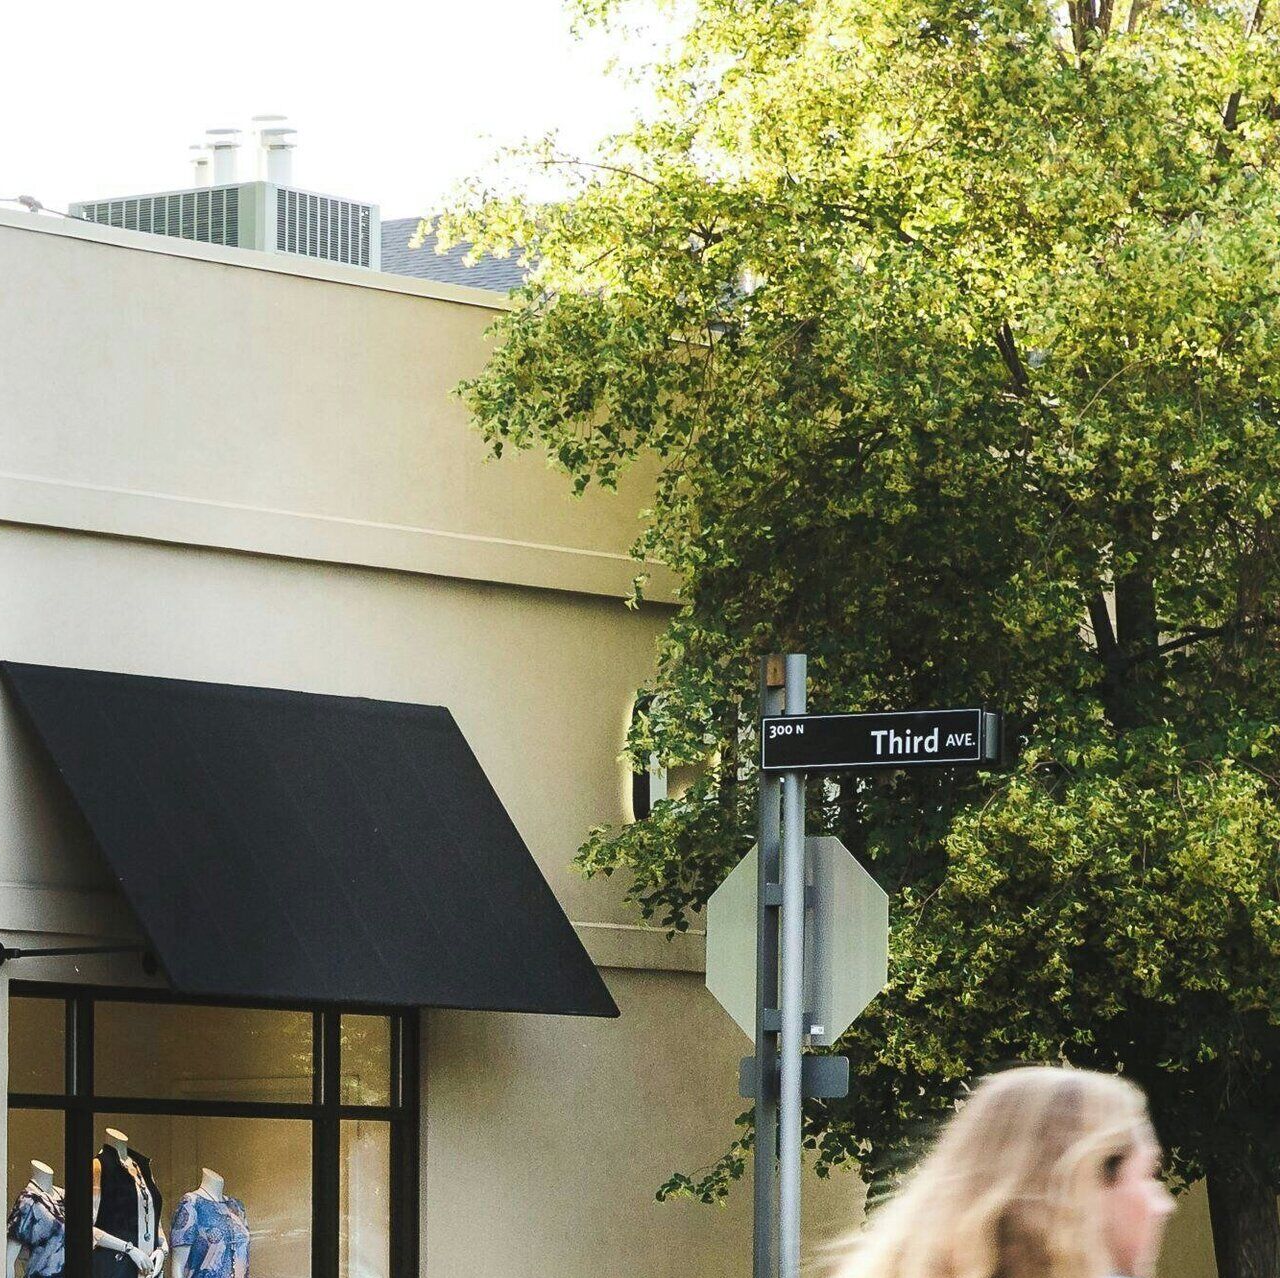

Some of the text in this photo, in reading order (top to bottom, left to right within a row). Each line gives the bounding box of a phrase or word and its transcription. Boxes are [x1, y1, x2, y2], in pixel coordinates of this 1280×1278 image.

[769, 724, 804, 738] 300 N
[870, 727, 976, 755] Third AVE.
